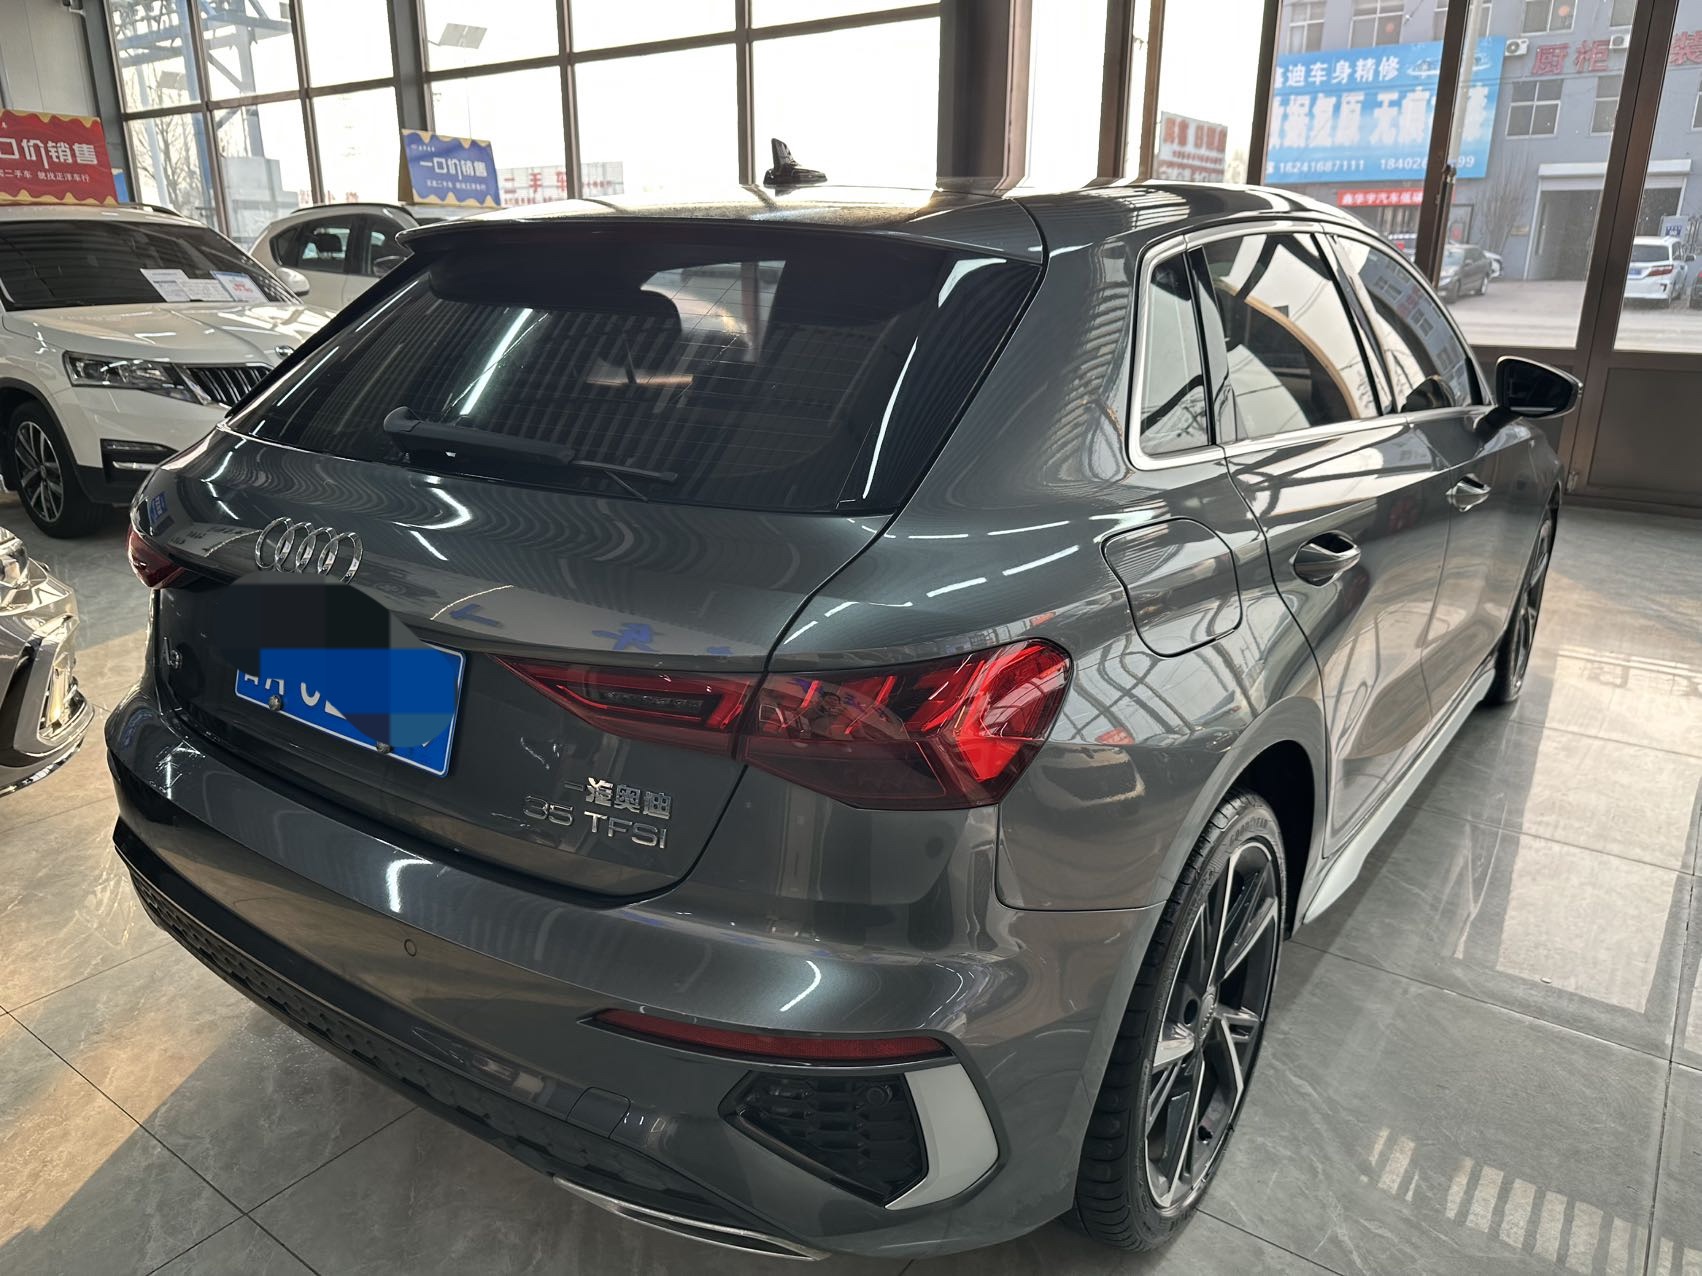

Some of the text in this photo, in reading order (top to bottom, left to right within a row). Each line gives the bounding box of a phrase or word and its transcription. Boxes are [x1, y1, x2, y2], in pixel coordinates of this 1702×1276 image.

[1532, 39, 1610, 74] 厨柜
[0, 137, 98, 169] 口价销售
[419, 157, 488, 182] 一口价销售
[564, 776, 672, 820] 一汽奥迪
[523, 795, 667, 849] 35 TFSI
